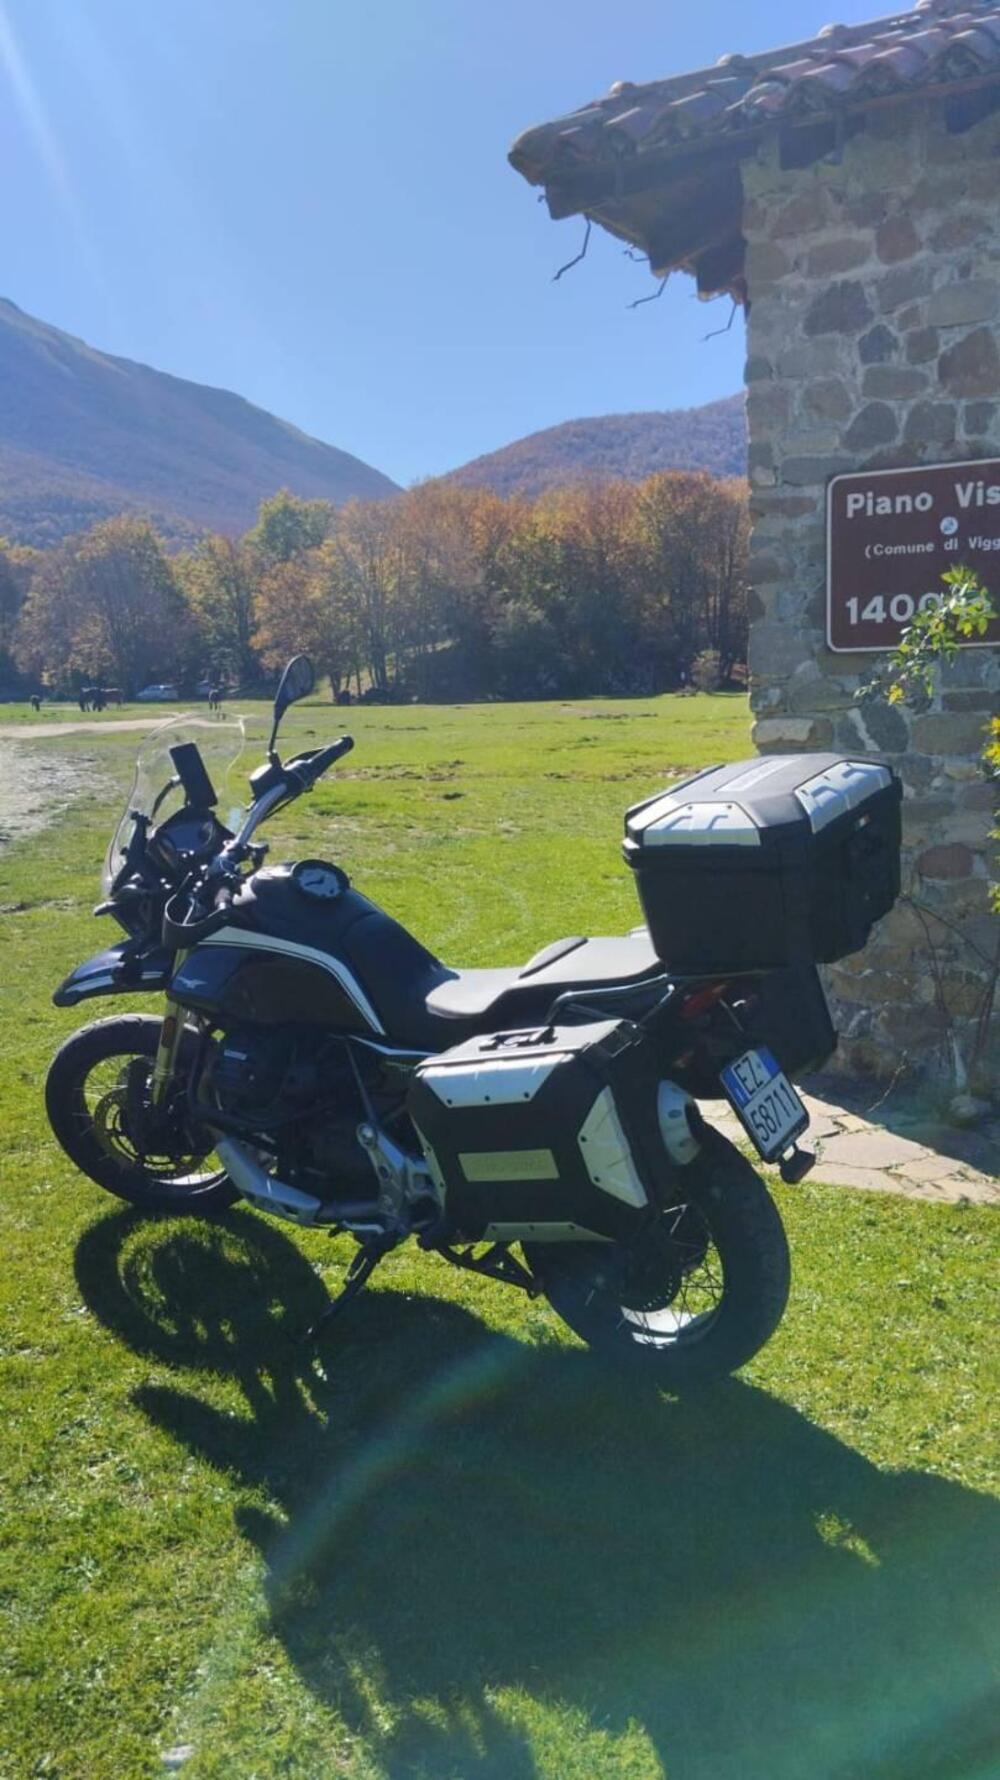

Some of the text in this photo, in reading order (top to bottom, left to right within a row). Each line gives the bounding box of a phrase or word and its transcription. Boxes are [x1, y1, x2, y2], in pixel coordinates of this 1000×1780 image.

[846, 481, 1000, 518] Piano Vis
[865, 541, 935, 559] (Comune
[944, 539, 958, 550] di
[734, 1057, 763, 1095] EZ
[750, 1083, 798, 1142] 58711
